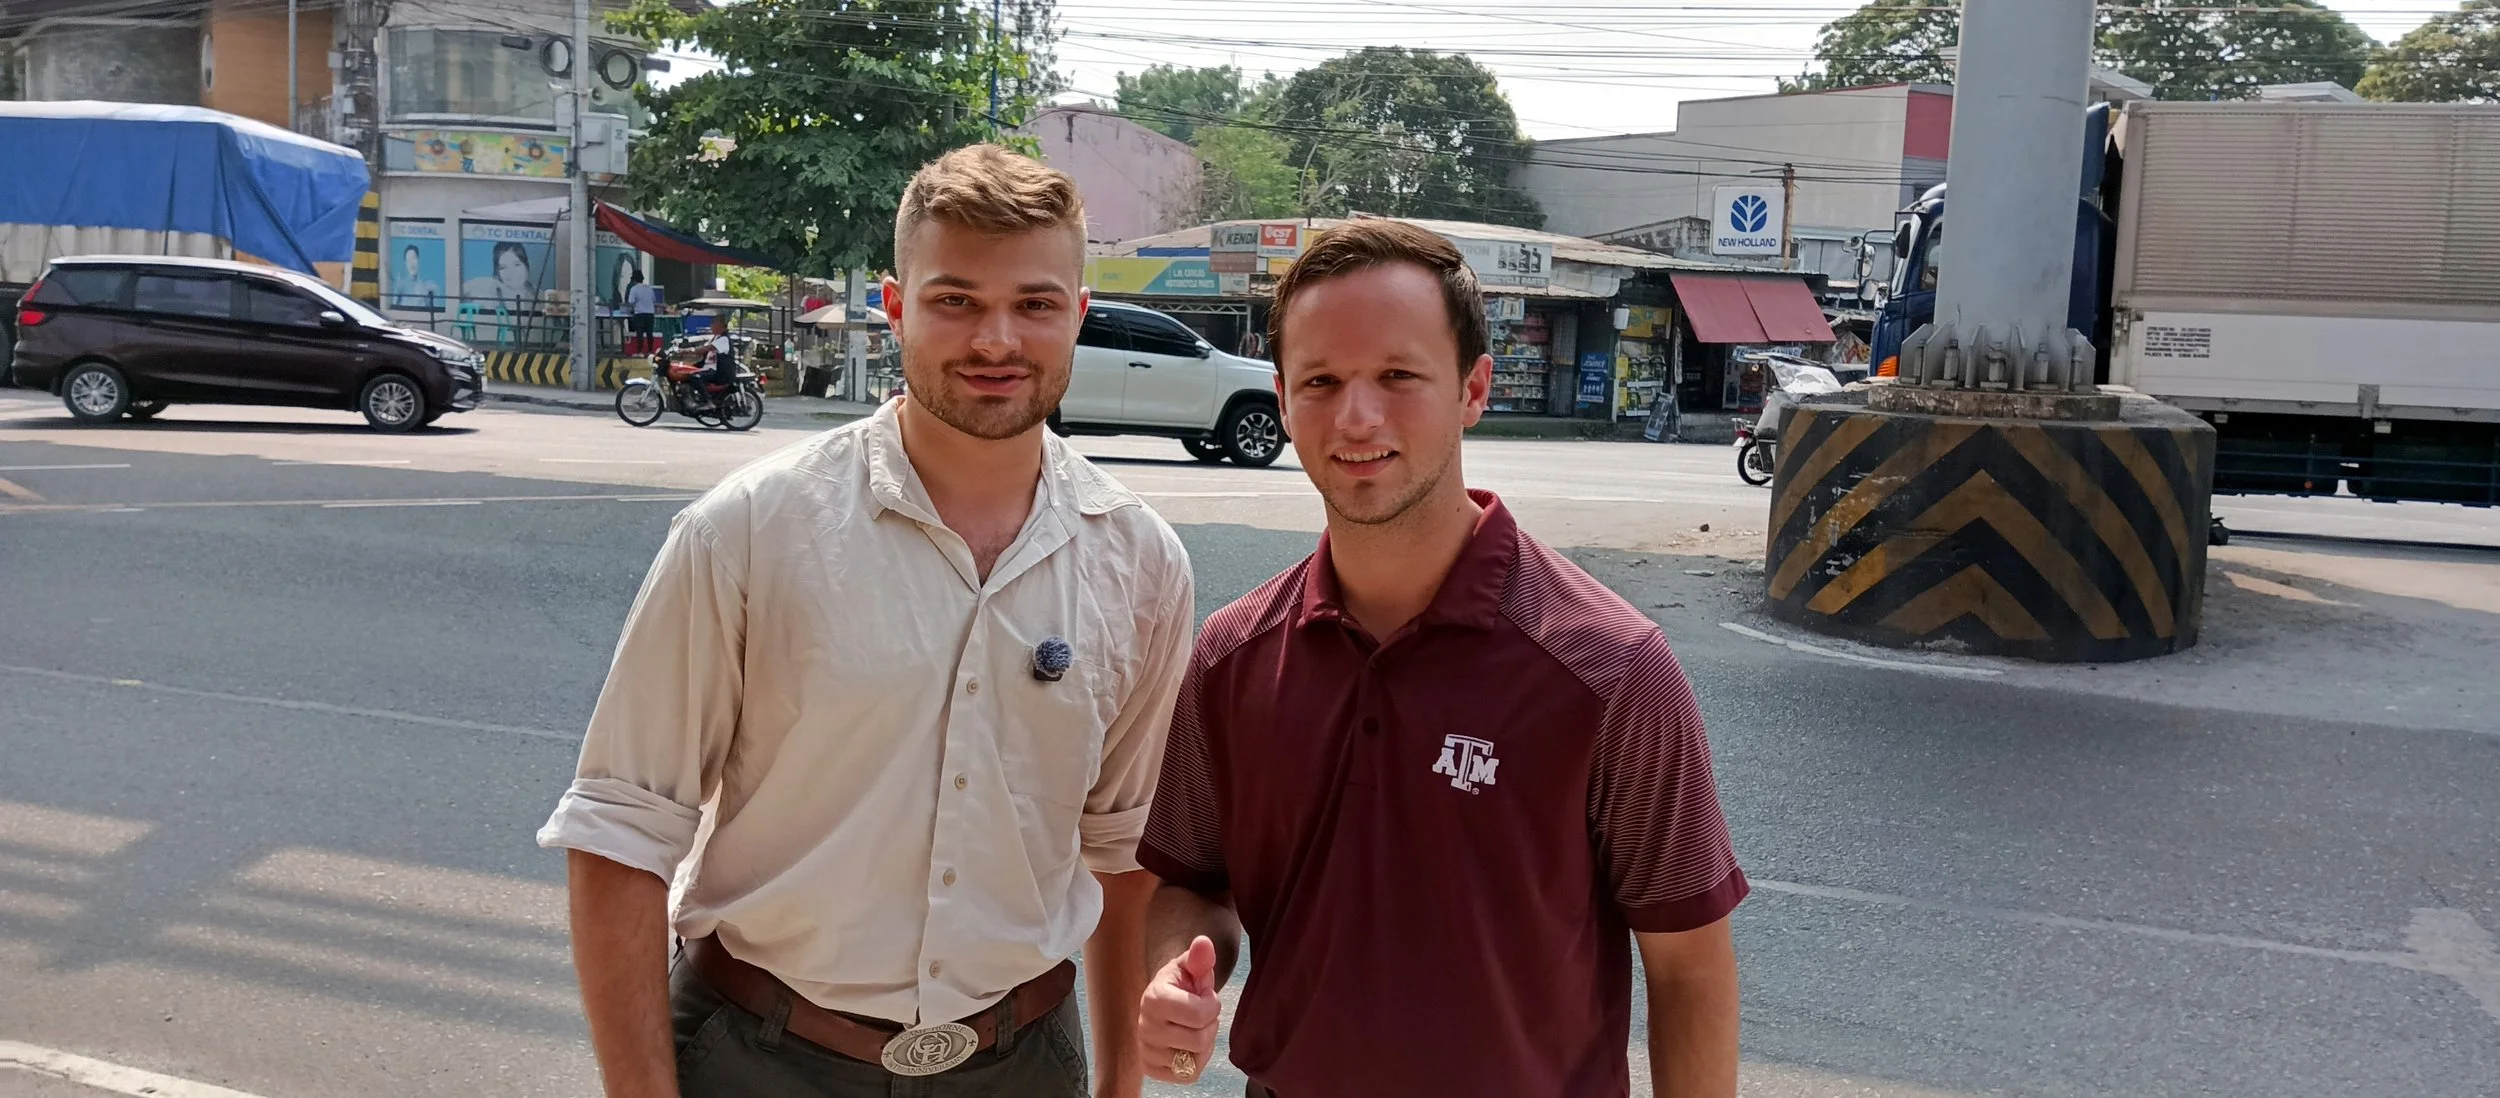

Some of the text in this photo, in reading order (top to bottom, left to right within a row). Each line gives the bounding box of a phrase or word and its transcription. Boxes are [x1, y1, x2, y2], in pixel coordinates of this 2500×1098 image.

[487, 228, 551, 241] TC DENTAL
[1226, 233, 1257, 246] KENDA
[1718, 238, 1777, 248] NEW HOLLAND
[931, 1024, 966, 1034] HORNE
